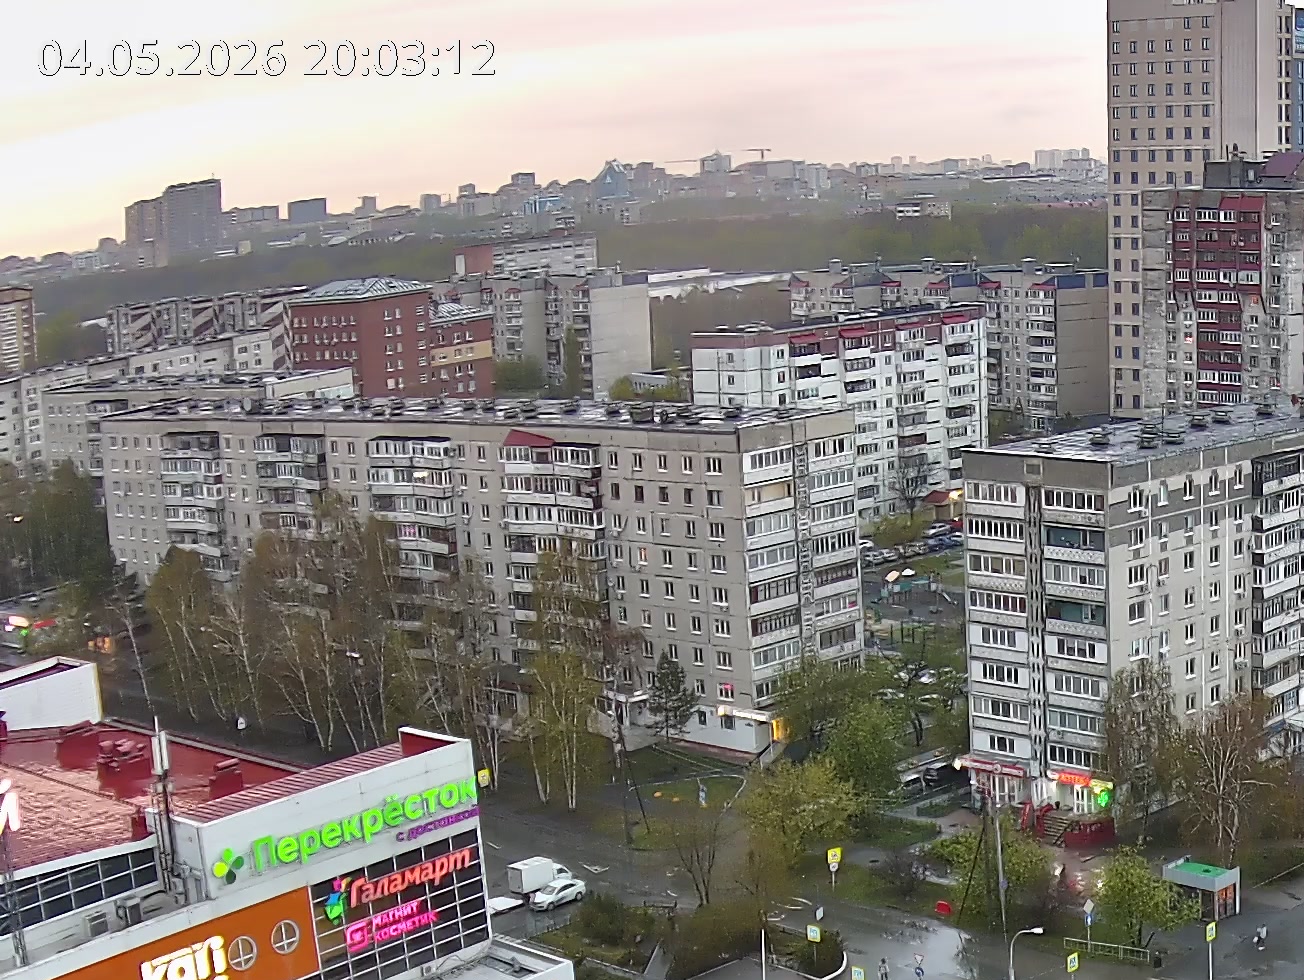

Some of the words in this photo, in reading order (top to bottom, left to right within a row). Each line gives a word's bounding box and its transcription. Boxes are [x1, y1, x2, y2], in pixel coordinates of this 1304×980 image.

[252, 775, 478, 872] Перекрёсток
[350, 848, 473, 908] Галамарт
[372, 901, 420, 927] МАГНИТ
